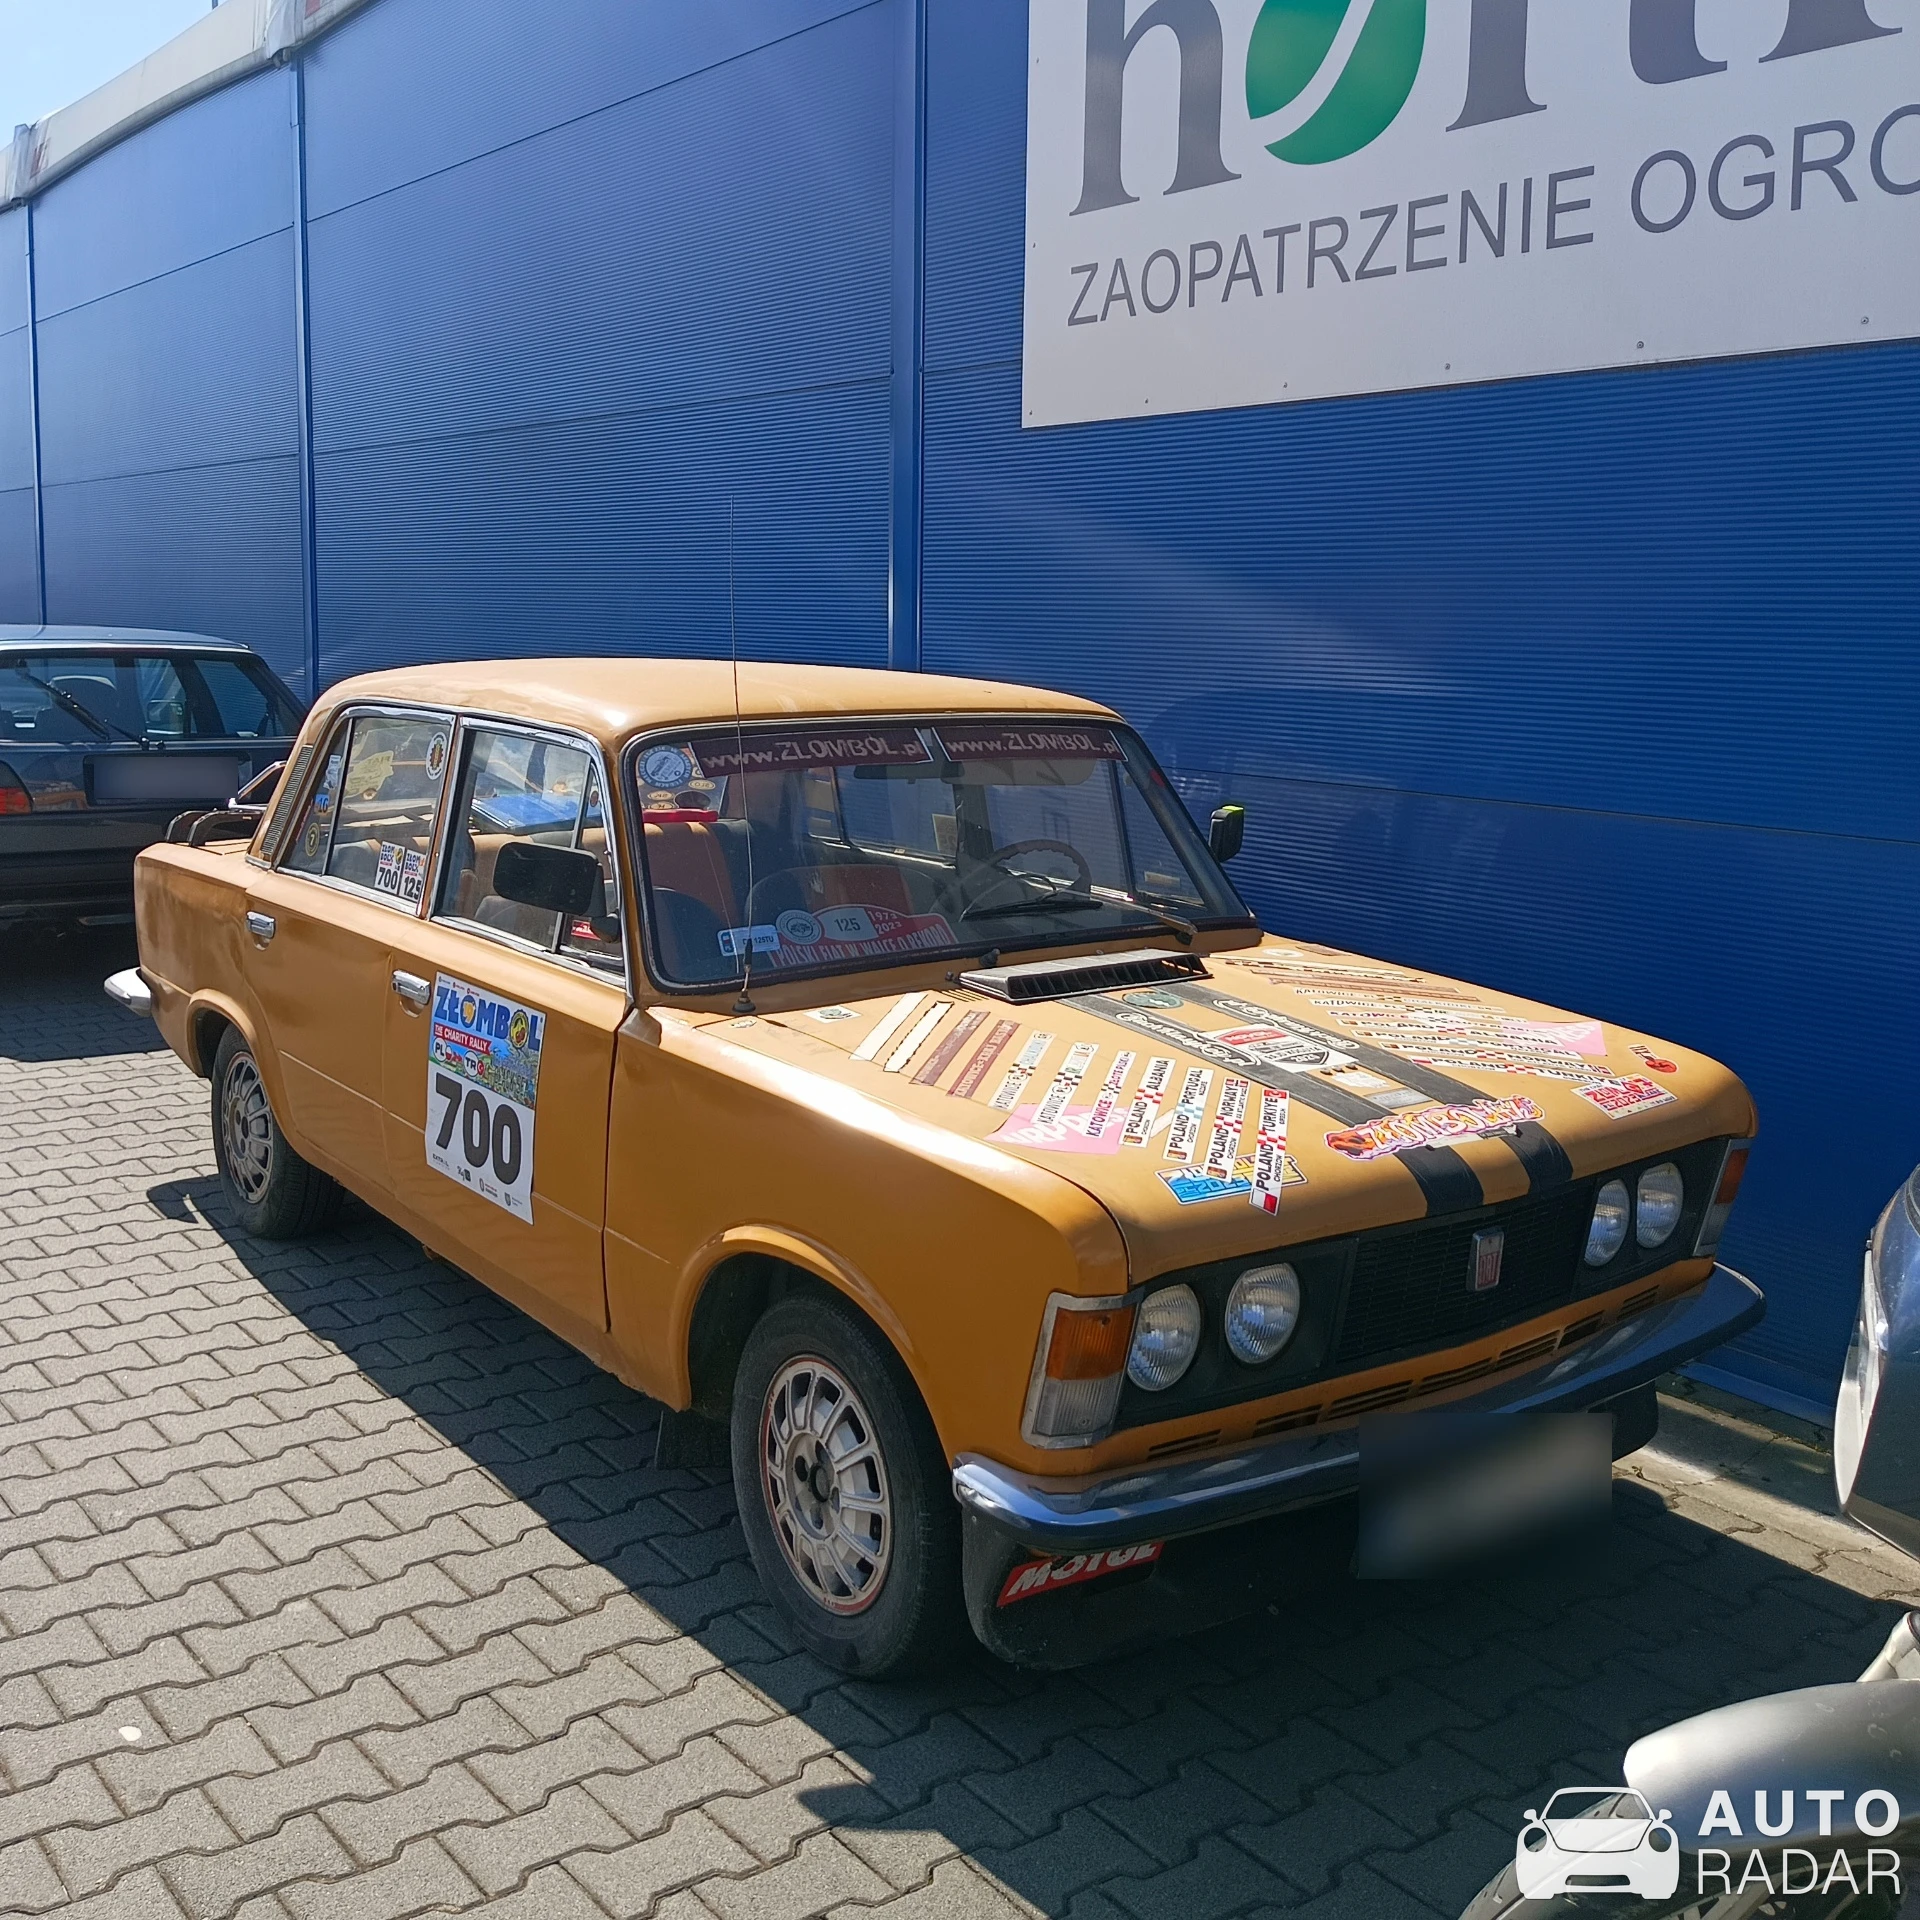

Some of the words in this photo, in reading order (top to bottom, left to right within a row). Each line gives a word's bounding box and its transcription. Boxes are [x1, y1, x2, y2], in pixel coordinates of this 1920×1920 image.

[1068, 165, 1595, 327] ZAOPATRZENIE
[1631, 103, 1920, 234] OGRO
[377, 866, 399, 890] 700
[403, 875, 423, 900] 125
[833, 917, 861, 933] 125
[867, 910, 899, 922] 1973
[874, 922, 903, 935] 2023
[434, 1042, 446, 1057] PL
[443, 1027, 469, 1048] CHARITY
[469, 1037, 489, 1052] RALLY
[465, 1056, 477, 1071] TR
[1430, 1057, 1509, 1069] POLAND
[1507, 1053, 1588, 1069] NORWAY
[1127, 1100, 1149, 1135] POLAND
[1145, 1059, 1171, 1091] ALBANIA
[1169, 1113, 1190, 1150] POLAND
[1181, 1069, 1204, 1105] PORTUGAL
[435, 1071, 522, 1185] 700
[1085, 1098, 1114, 1138] KATOWICE
[1208, 1127, 1230, 1167] POLAND
[1219, 1085, 1239, 1118] NORWAY
[1255, 1142, 1275, 1192] POLAND
[1005, 1543, 1158, 1597] MOTUL
